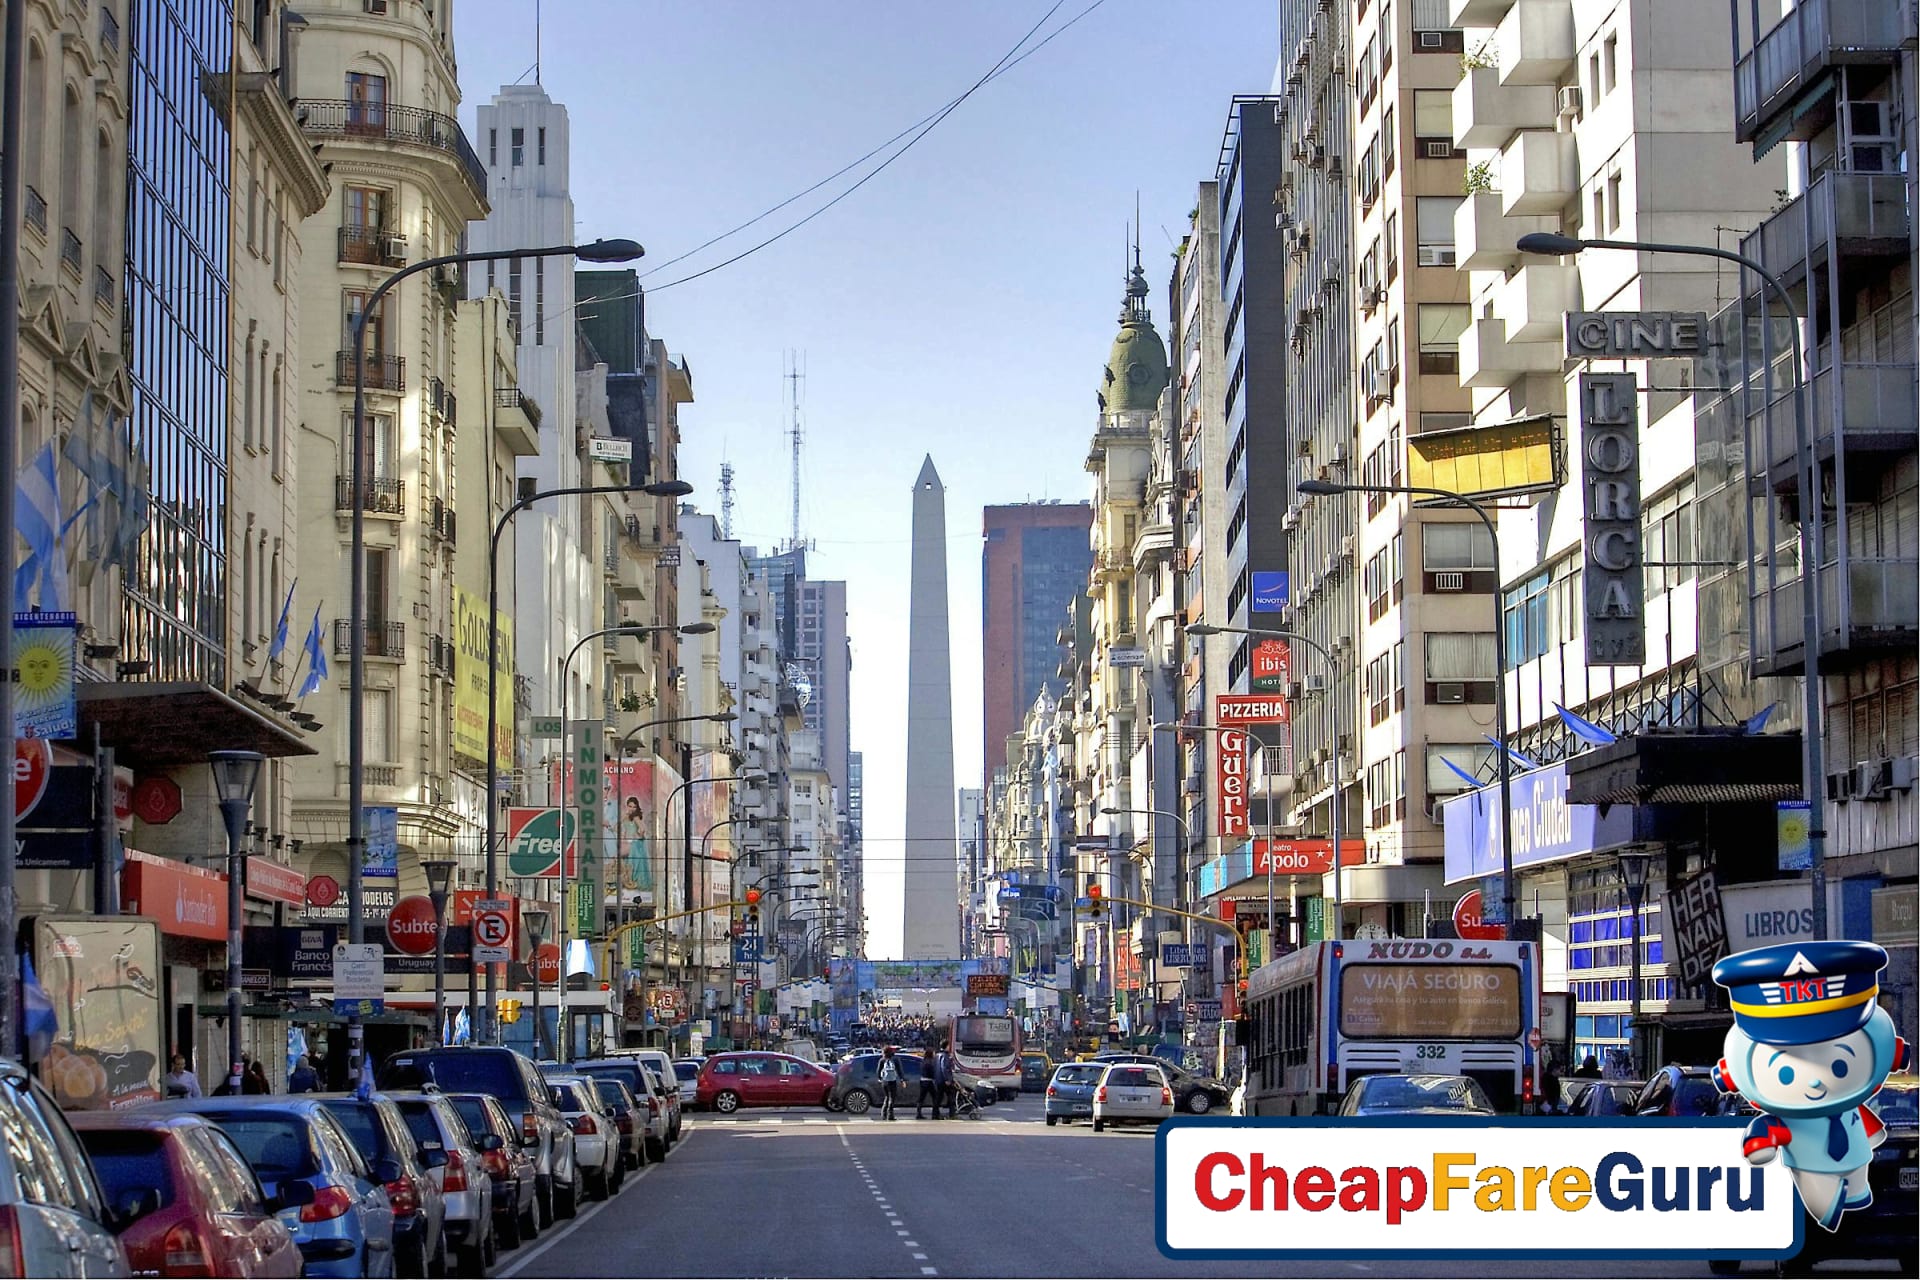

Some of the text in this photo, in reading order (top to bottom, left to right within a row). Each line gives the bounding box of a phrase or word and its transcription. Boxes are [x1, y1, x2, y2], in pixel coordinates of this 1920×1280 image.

[1577, 319, 1699, 350] CINE
[1588, 382, 1637, 620] LORCA
[1256, 597, 1288, 605] NOVOTEL
[458, 592, 511, 677] GOLDSEIN
[1261, 657, 1287, 671] ibis
[1219, 702, 1284, 719] PIZZERIA
[535, 721, 561, 733] LOS
[1220, 731, 1244, 835] Güerr
[579, 728, 597, 882] INMORTAL
[1533, 775, 1572, 849] Ciudad
[509, 832, 562, 854] Free
[1260, 850, 1309, 873] Apolo
[1671, 873, 1718, 929] HER
[392, 918, 438, 934] Subte
[1677, 908, 1724, 958] NAN
[1745, 908, 1814, 938] LIBROS
[295, 951, 329, 961] Banco
[1368, 942, 1453, 959] NUDO
[292, 960, 332, 972] Francés
[398, 959, 436, 969] Uruguay
[1363, 971, 1500, 993] VIAJÁ SEGURO
[1416, 1045, 1446, 1059] 332
